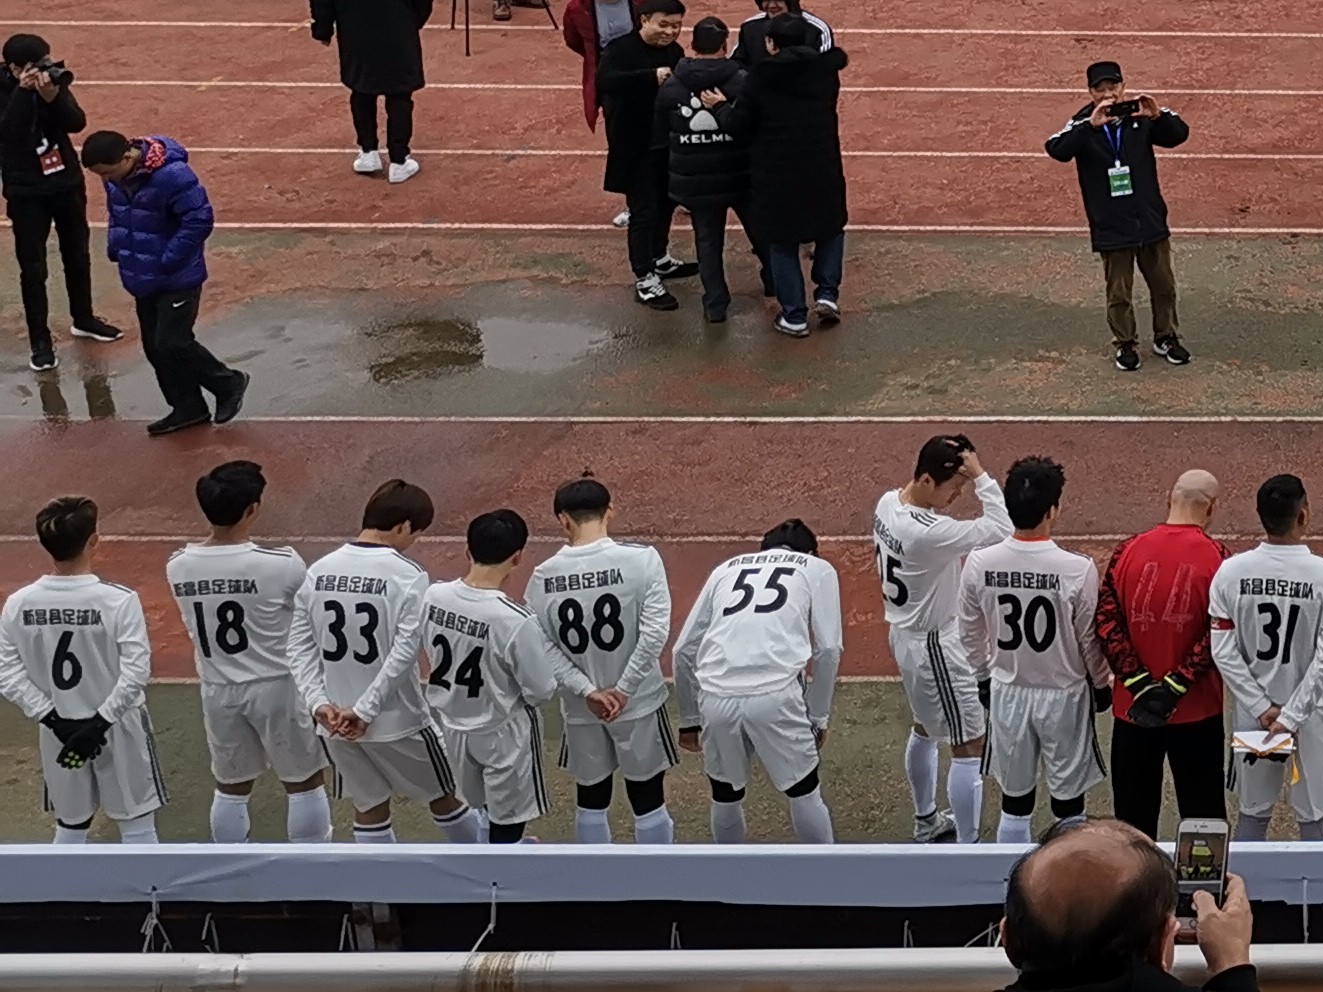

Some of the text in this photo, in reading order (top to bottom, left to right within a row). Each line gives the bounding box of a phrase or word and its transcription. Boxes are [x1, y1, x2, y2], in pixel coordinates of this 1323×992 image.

[173, 578, 259, 597] 新昌县足球队
[314, 574, 388, 597] 新昌县足球队
[544, 567, 624, 595] 新昌县足球队
[722, 567, 796, 617] 55
[984, 570, 1061, 591] 新昌县足球队
[1130, 560, 1195, 632] 44
[1240, 577, 1315, 599] 新昌县足球队
[22, 608, 103, 626] 新昌县足球队
[192, 600, 249, 658] 18
[322, 599, 380, 665] 33
[428, 605, 491, 639] 新昌县足球队
[557, 593, 625, 655] 88
[997, 593, 1057, 653] 30
[1256, 603, 1301, 664] 31
[51, 630, 83, 691] 6
[428, 632, 484, 698] 24
